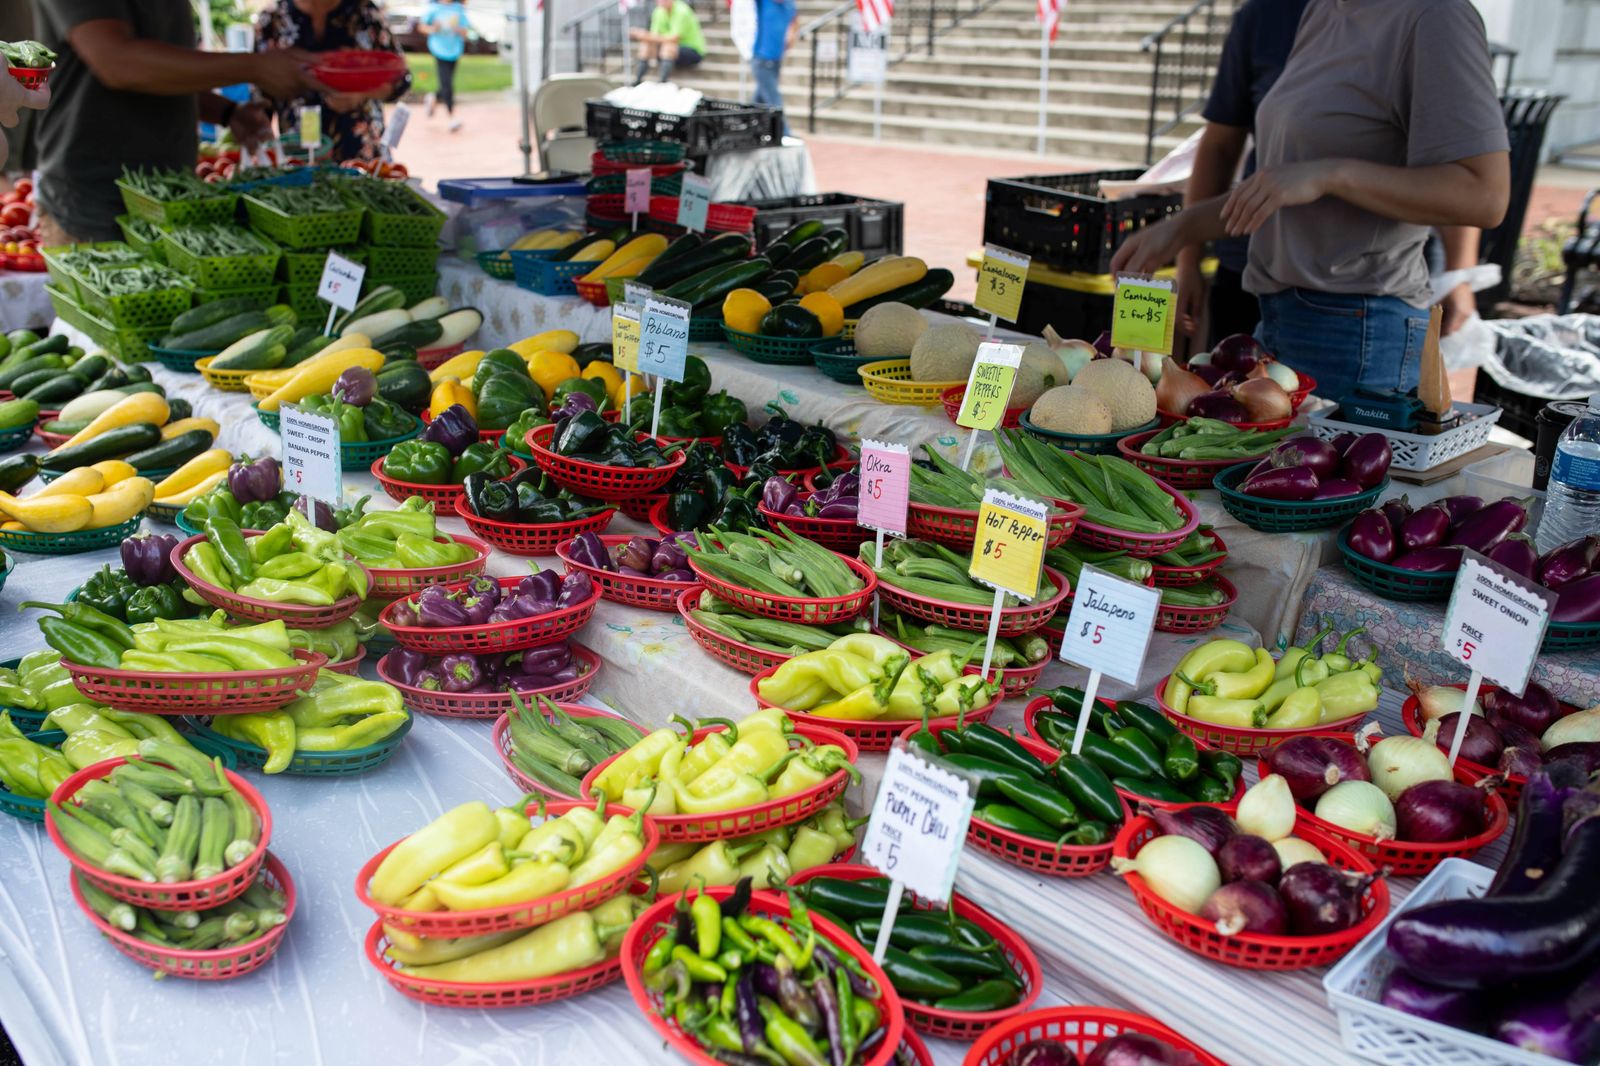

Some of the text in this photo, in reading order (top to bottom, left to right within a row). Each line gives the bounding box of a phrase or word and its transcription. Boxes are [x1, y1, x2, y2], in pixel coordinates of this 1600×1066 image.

[1123, 289, 1167, 308] Cantaloupe
[1120, 310, 1127, 319] 2
[645, 316, 687, 340] Poblano
[644, 340, 671, 364] $5
[974, 381, 1002, 399] PEPPERS
[287, 428, 304, 439] SWEET
[308, 434, 326, 445] CRISPY
[298, 420, 330, 434] HOMEGROWN
[288, 442, 330, 460] BANANA PEPPER
[288, 455, 304, 466] PRICE
[992, 496, 1044, 520] 100% HOMEGROWN
[1083, 587, 1136, 620] Jalapeno
[1475, 573, 1540, 616] 100% HOMEGROWN
[1471, 588, 1529, 627] SWEET ONION
[1461, 622, 1484, 642] PRICE
[893, 780, 941, 811] HOT PEPPER
[880, 821, 903, 842] PRICE
